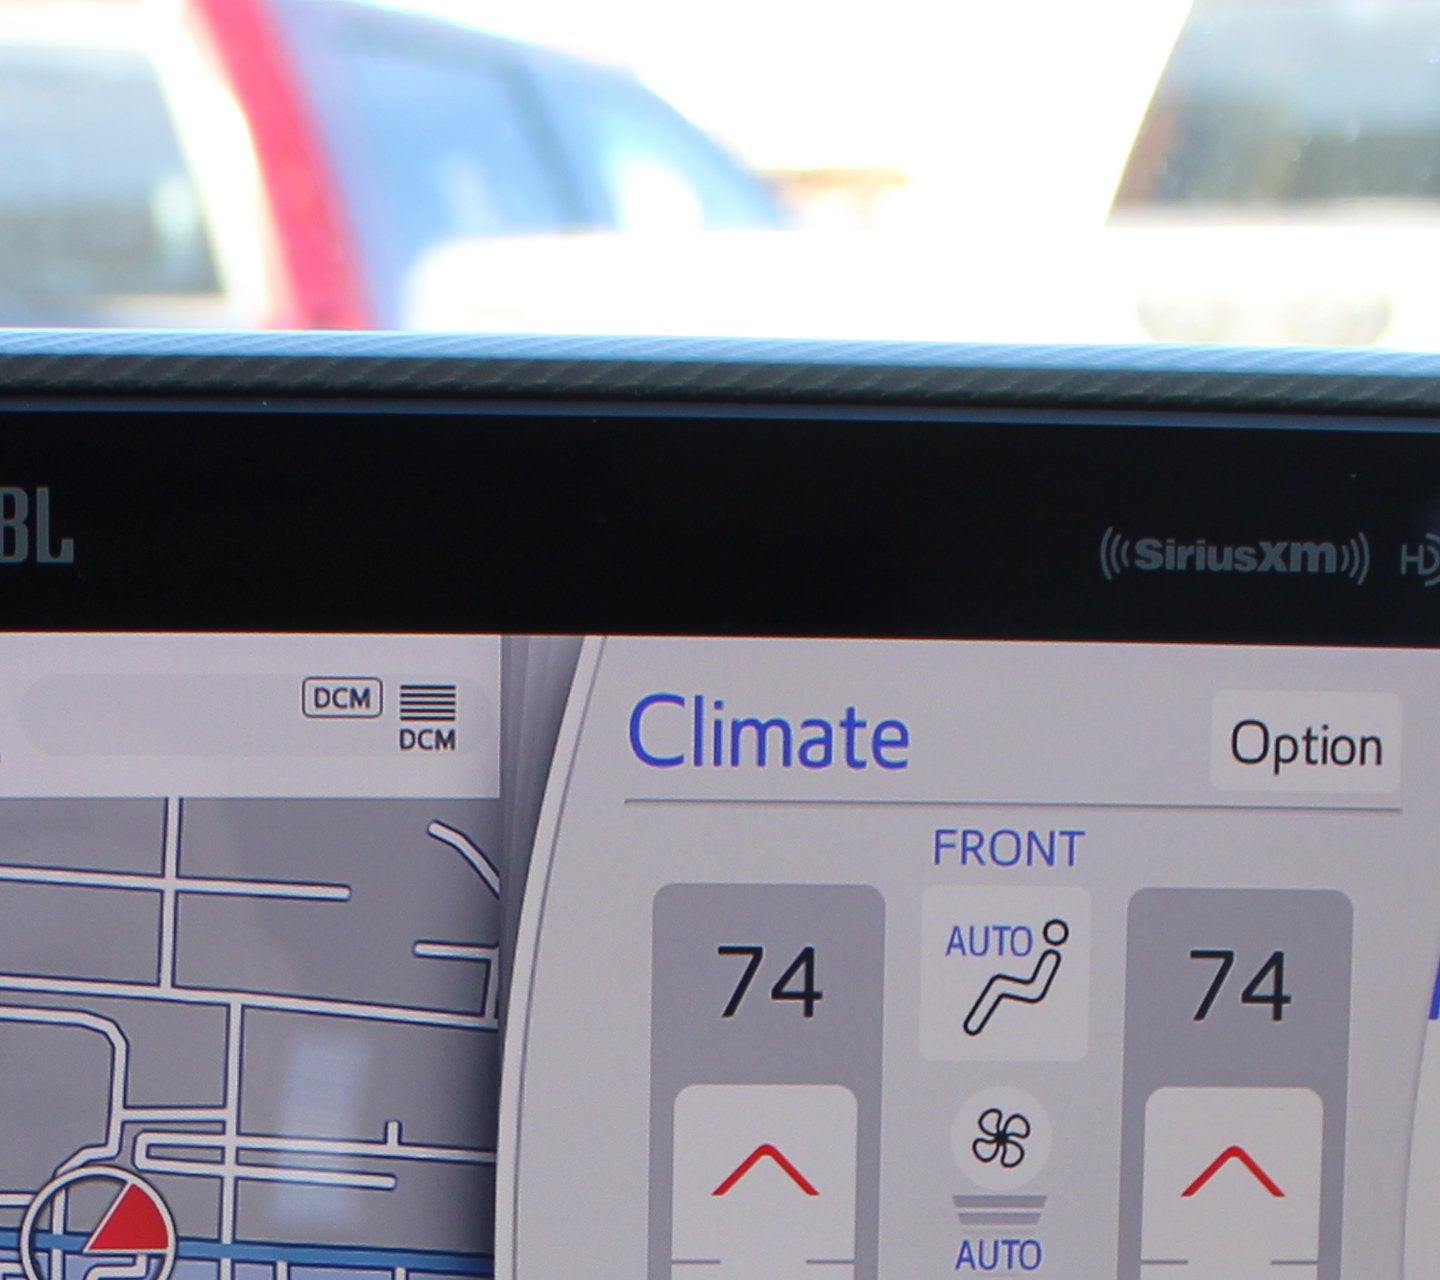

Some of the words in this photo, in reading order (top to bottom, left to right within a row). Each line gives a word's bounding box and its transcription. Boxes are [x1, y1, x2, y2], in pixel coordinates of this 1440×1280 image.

[313, 686, 370, 711] DCM
[399, 728, 457, 751] DCM
[627, 693, 911, 770] Climate
[1230, 719, 1383, 775] Option
[933, 828, 1085, 866] FRONT
[946, 926, 1033, 958] AUTO
[716, 945, 823, 1018] 74
[1189, 949, 1291, 1021] 74
[955, 1240, 1041, 1272] AUTO
